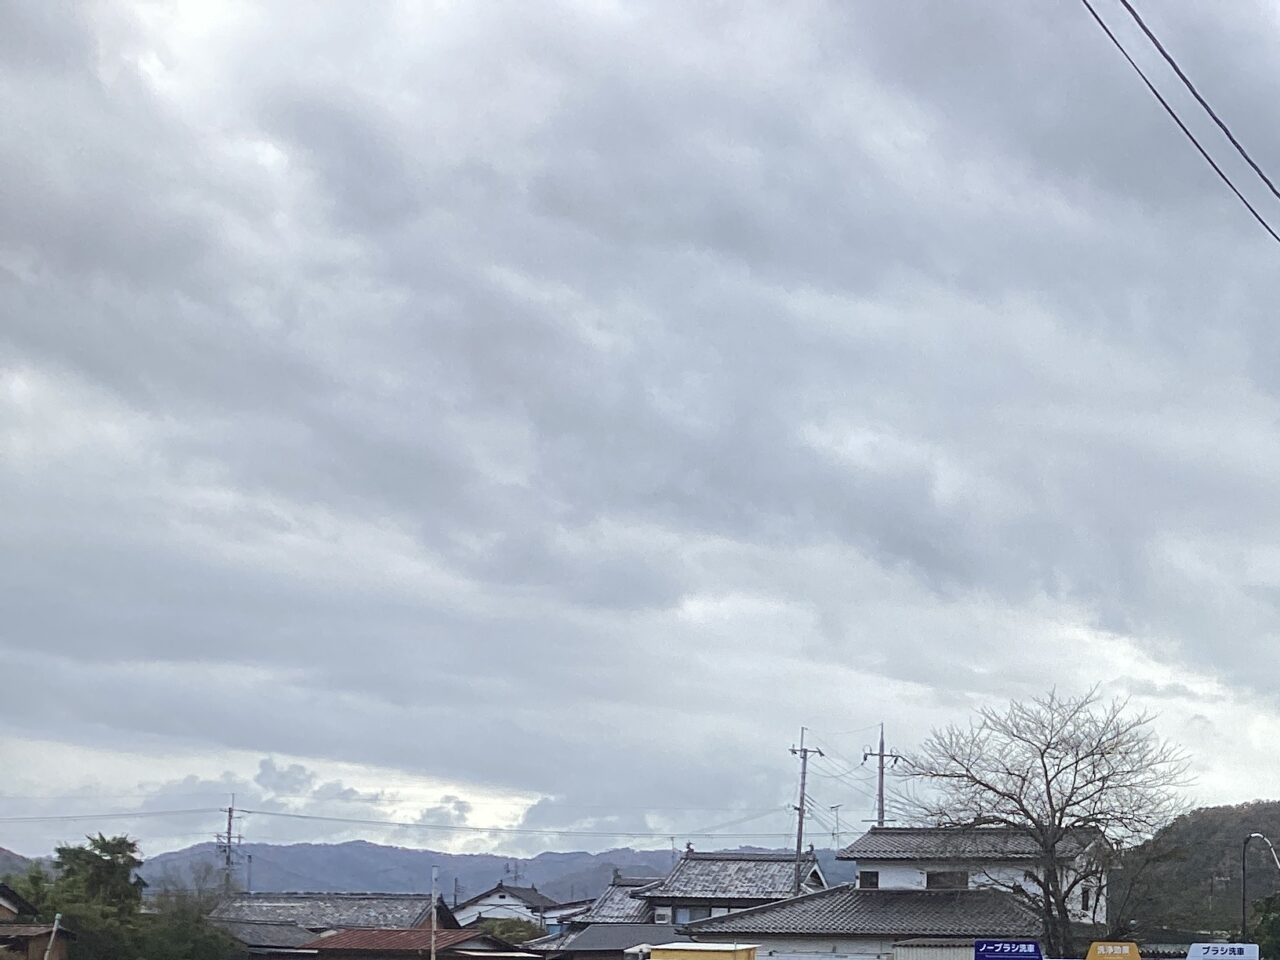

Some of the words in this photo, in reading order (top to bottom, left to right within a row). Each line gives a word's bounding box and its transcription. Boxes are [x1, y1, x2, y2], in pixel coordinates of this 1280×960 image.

[978, 944, 1036, 953] ノーブラシ洗車
[1202, 946, 1245, 956] ブラシ洗車
